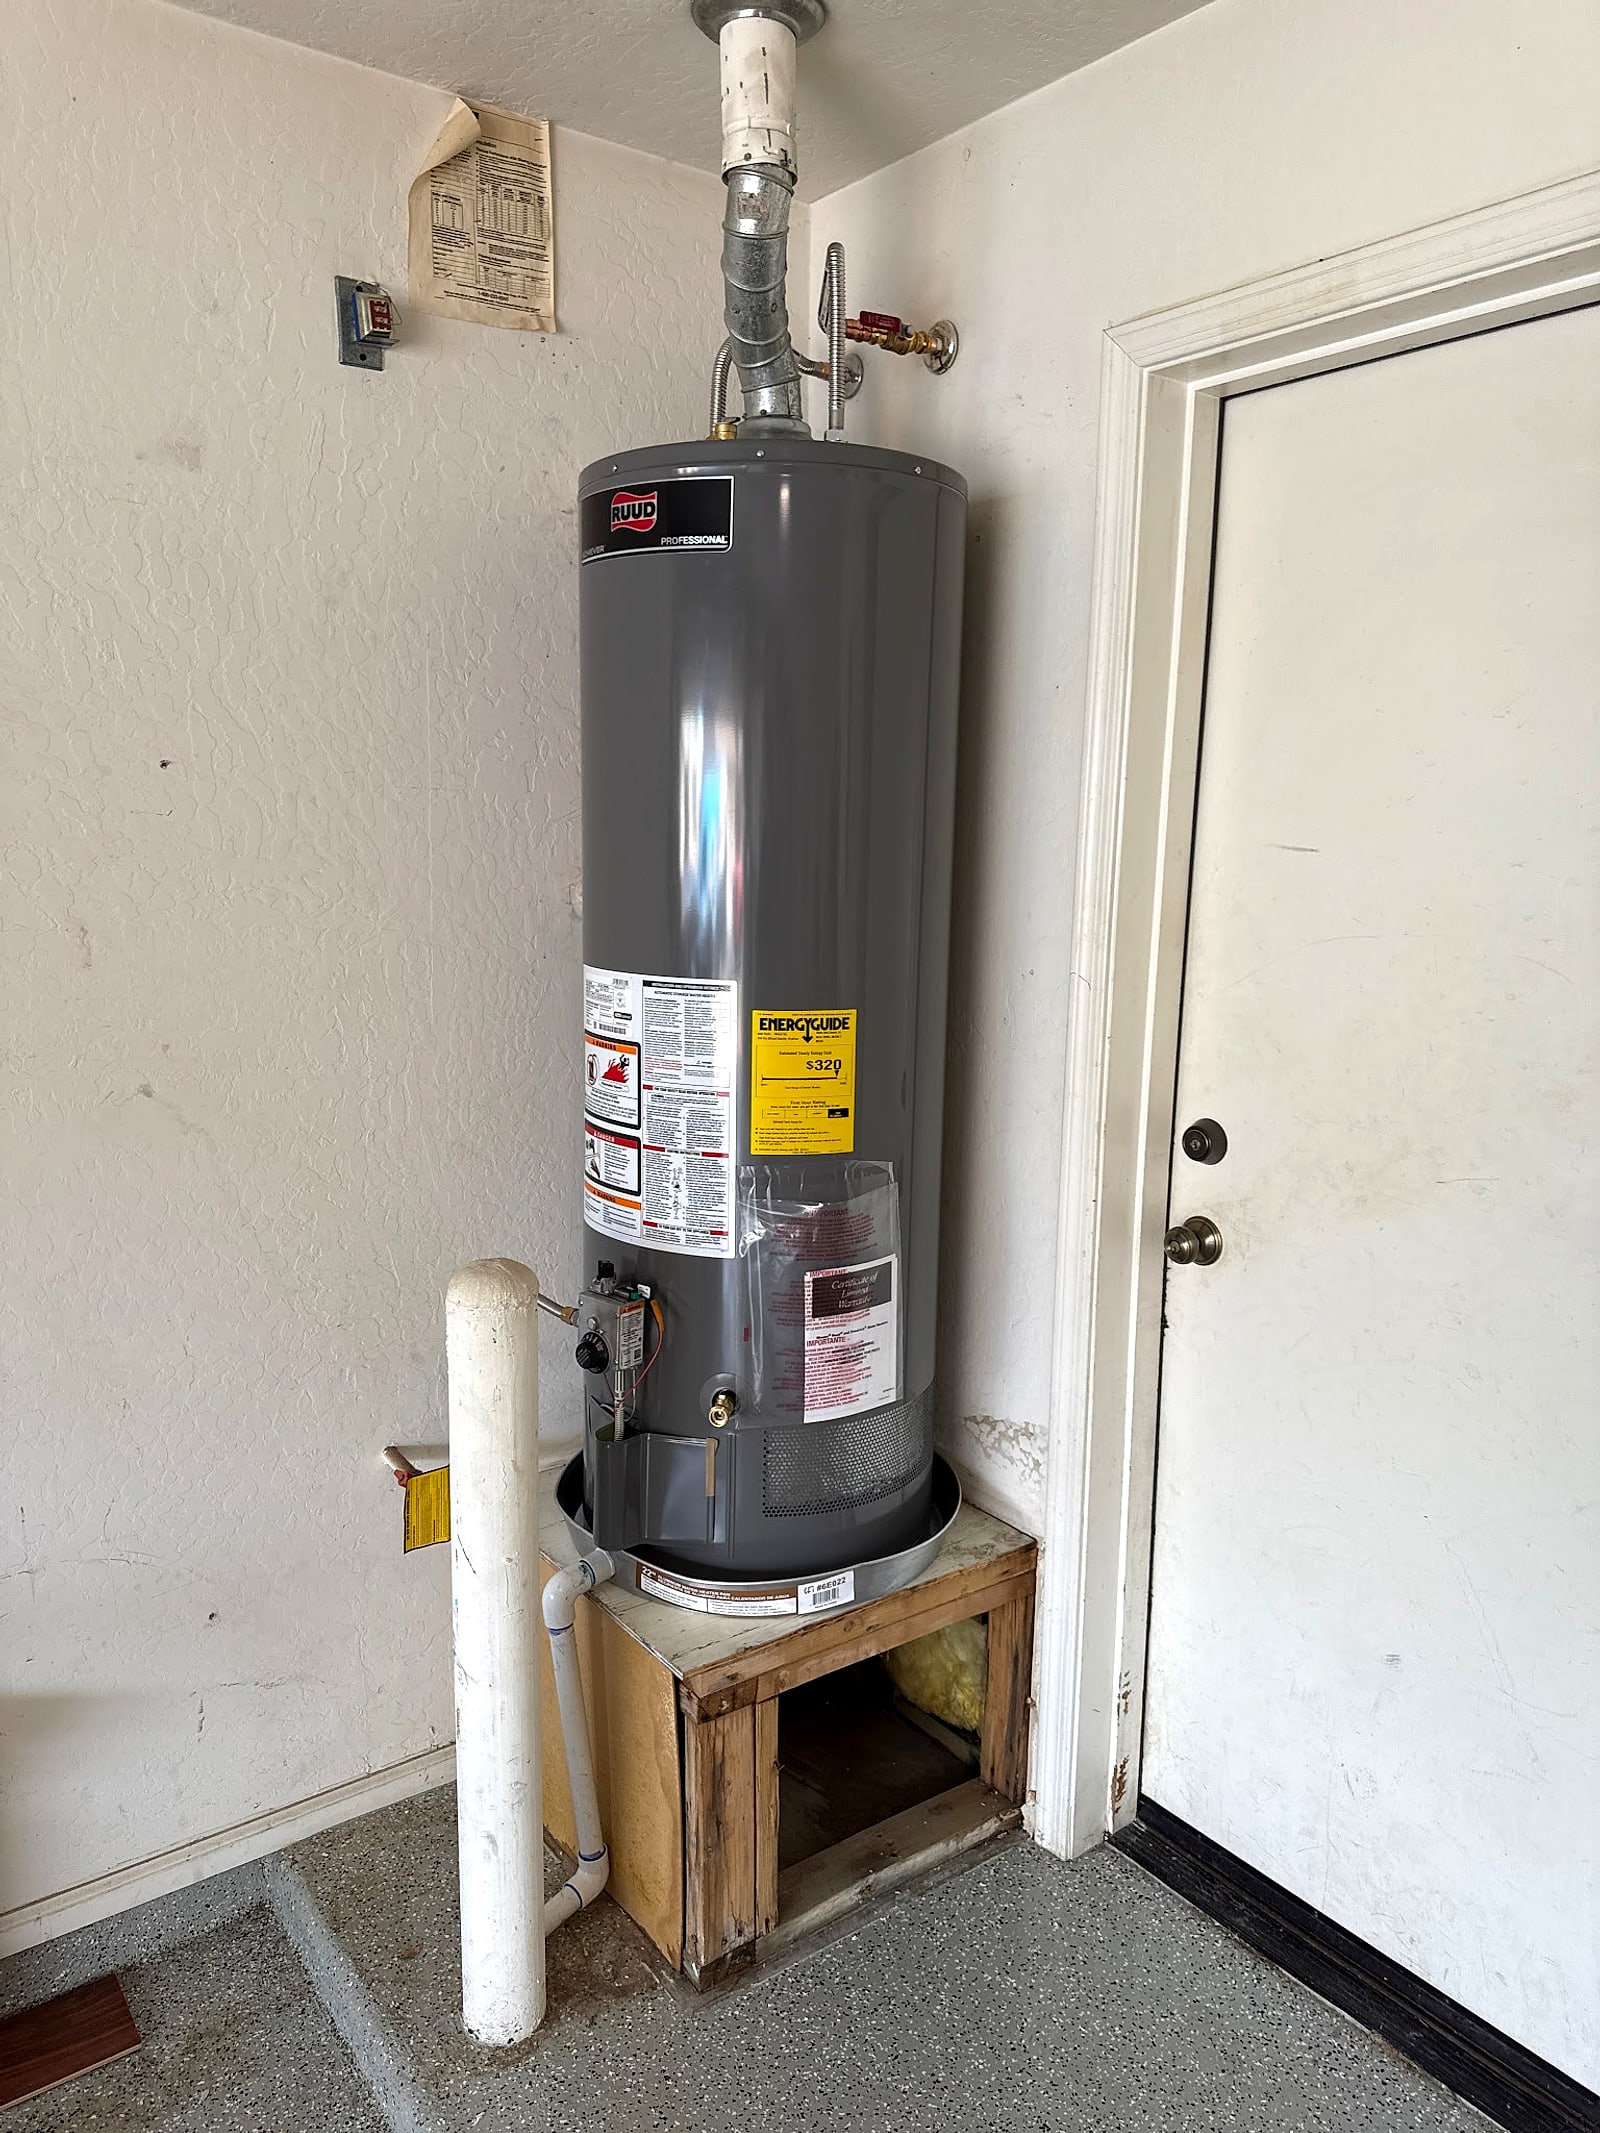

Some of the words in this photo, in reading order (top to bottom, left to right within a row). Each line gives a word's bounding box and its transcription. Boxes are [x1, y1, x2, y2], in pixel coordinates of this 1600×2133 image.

[612, 501, 656, 522] RUUD
[660, 536, 727, 546] PROFESSIONAL
[760, 1017, 850, 1032] ENERGYGUIDE
[806, 1059, 842, 1071] $320
[809, 1269, 846, 1278] IMPORTANT
[831, 1276, 869, 1290] Certificate
[870, 1271, 880, 1283] of
[806, 1336, 846, 1347] IMPORTANTE
[816, 1576, 846, 1592] #6E022
